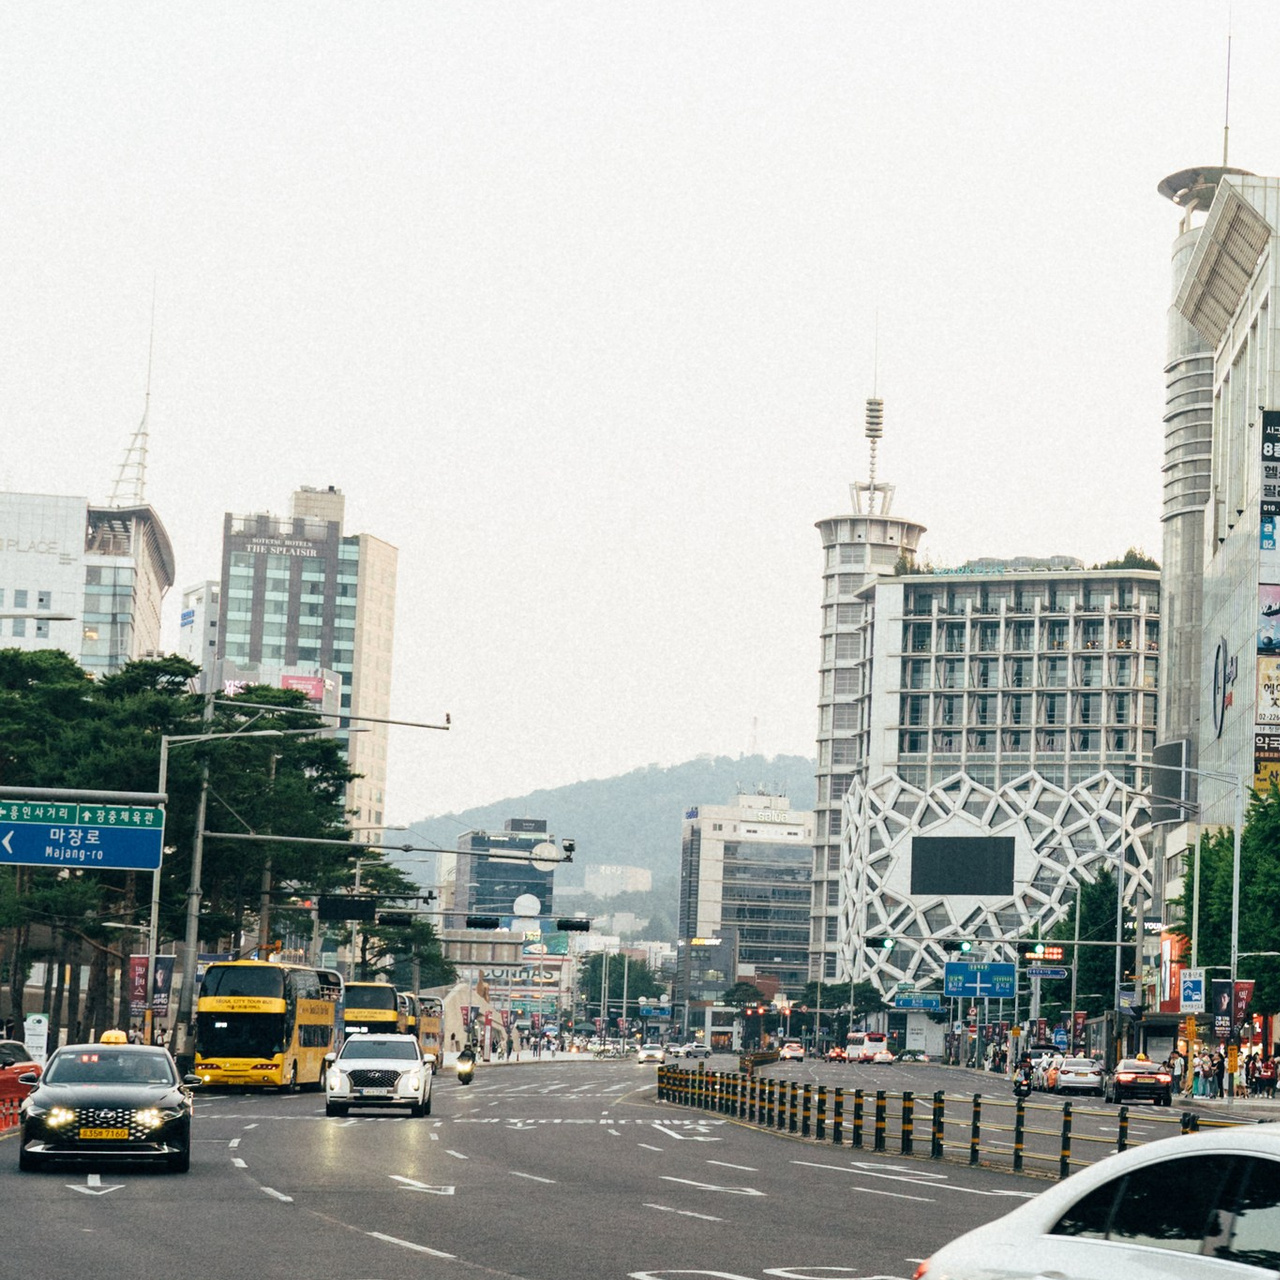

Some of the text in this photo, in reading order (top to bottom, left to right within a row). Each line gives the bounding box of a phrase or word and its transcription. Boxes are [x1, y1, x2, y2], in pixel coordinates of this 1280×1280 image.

[7, 538, 59, 555] PLACE
[246, 544, 317, 557] THE SPLAISIR
[252, 538, 312, 548] SOTETSU HOTELS
[9, 805, 69, 820] 흥인사거리
[96, 809, 155, 825] 장충체육관
[49, 827, 101, 847] 마장로
[45, 845, 104, 862] Majang-ro
[105, 1128, 126, 1138] 7160
